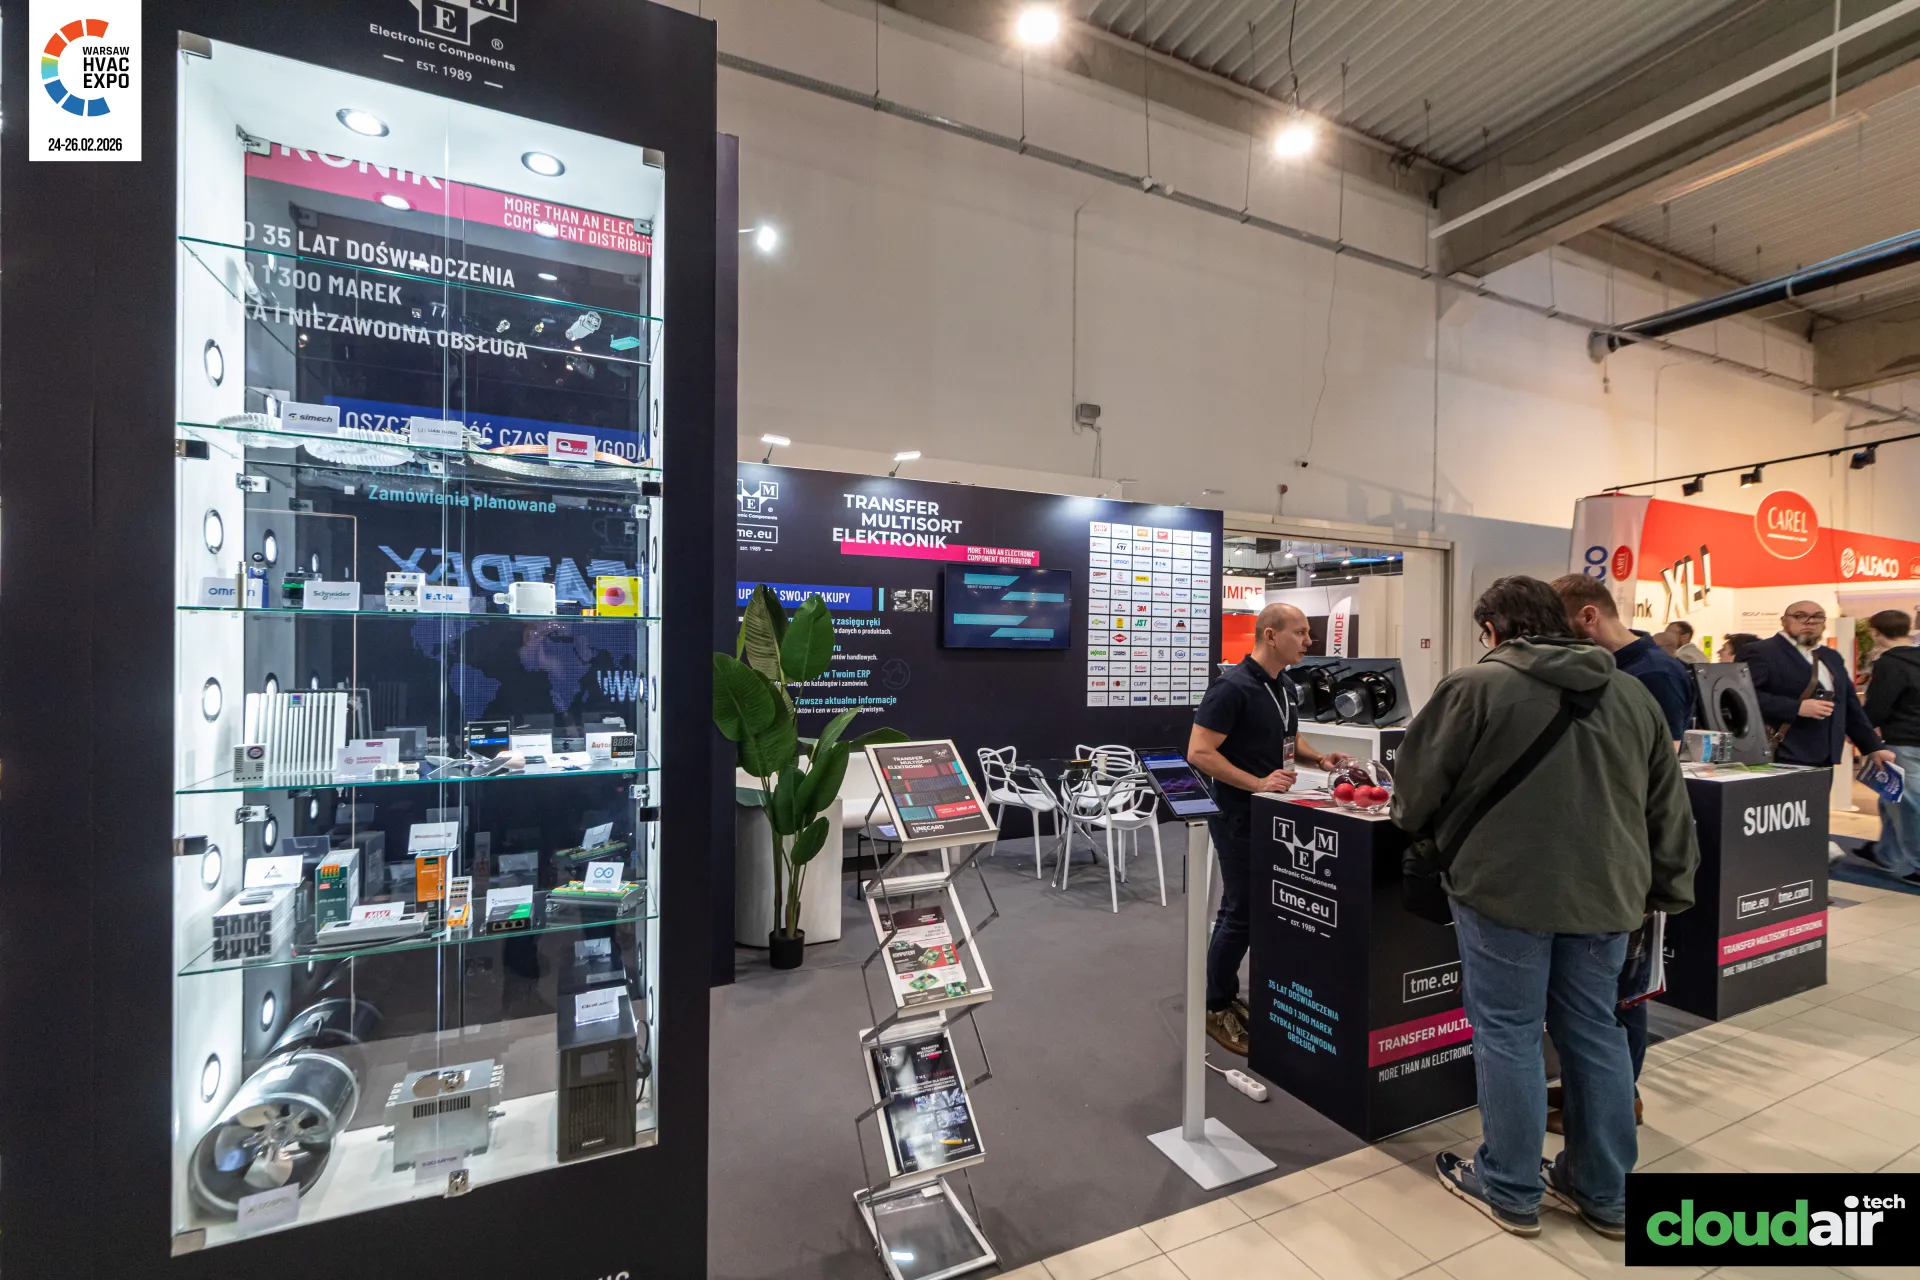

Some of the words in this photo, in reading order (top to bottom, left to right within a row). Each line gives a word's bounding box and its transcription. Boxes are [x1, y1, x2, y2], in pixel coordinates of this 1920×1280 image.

[369, 23, 435, 49] Electronic
[439, 43, 516, 71] Components
[416, 61, 438, 74] EST.
[442, 66, 472, 82] 1989
[504, 196, 540, 216] MORE
[544, 205, 579, 226] THAN
[583, 214, 600, 230] AN
[263, 224, 291, 248] 35
[298, 230, 340, 257] LAT
[328, 275, 402, 306] MAREK
[289, 307, 431, 345] NIEZAWODNA
[437, 330, 528, 359] OBSŁUGA
[298, 413, 333, 423] simech
[368, 484, 470, 507] Zamówienia
[474, 494, 557, 514] planowane
[843, 494, 939, 516] TRANSFER
[861, 512, 963, 534] MULTISORT
[1767, 506, 1808, 534] CAREL
[737, 529, 772, 539] me.eu
[832, 527, 947, 549] ELEKTRONIK
[967, 554, 998, 563] COMPONENT
[999, 556, 1032, 565] DISTRIBUTOR
[1005, 549, 1036, 558] ELECTRONIC
[1856, 555, 1900, 579] ALFACO
[313, 590, 351, 600] Schneider
[1223, 586, 1262, 600] IMIDE
[836, 617, 864, 627] zasięgu
[866, 617, 881, 628] ręki
[862, 628, 892, 636] produktach.
[846, 654, 878, 662] handlowych.
[811, 680, 838, 688] katalogów
[832, 670, 855, 678] Twoim
[857, 670, 871, 678] ERP
[824, 696, 857, 705] aktualne
[858, 696, 897, 706] informacje
[1273, 865, 1300, 879] Electronic
[1300, 873, 1337, 890] Components
[1279, 888, 1330, 918] tme.eu
[1741, 897, 1770, 912] tme.eu
[1778, 886, 1809, 903] tme.com
[1290, 919, 1300, 928] EST.
[1302, 921, 1316, 933] 1989
[1724, 938, 1756, 954] TRANSFER
[1756, 929, 1789, 945] MULTISORT
[1789, 919, 1823, 936] ELEKTRONIK
[1292, 981, 1312, 998] PONAD
[1410, 971, 1459, 994] tme.eu
[1268, 980, 1276, 990] 35
[1276, 984, 1288, 995] LAT
[1288, 989, 1340, 1022] DOŚWIADCZENIA
[1274, 998, 1292, 1016] PONAD
[1310, 1018, 1332, 1036] MAREK
[1269, 1012, 1292, 1030] SZYBKA
[1296, 1026, 1336, 1056] NIEZAWODNA
[1288, 1032, 1316, 1054] OBSŁUGA
[1378, 1027, 1436, 1053] TRANSFER
[1378, 1067, 1399, 1083] MORE
[1401, 1060, 1420, 1076] THAN
[1421, 1057, 1431, 1070] AN
[1432, 1044, 1474, 1067] ELECTRONIC
